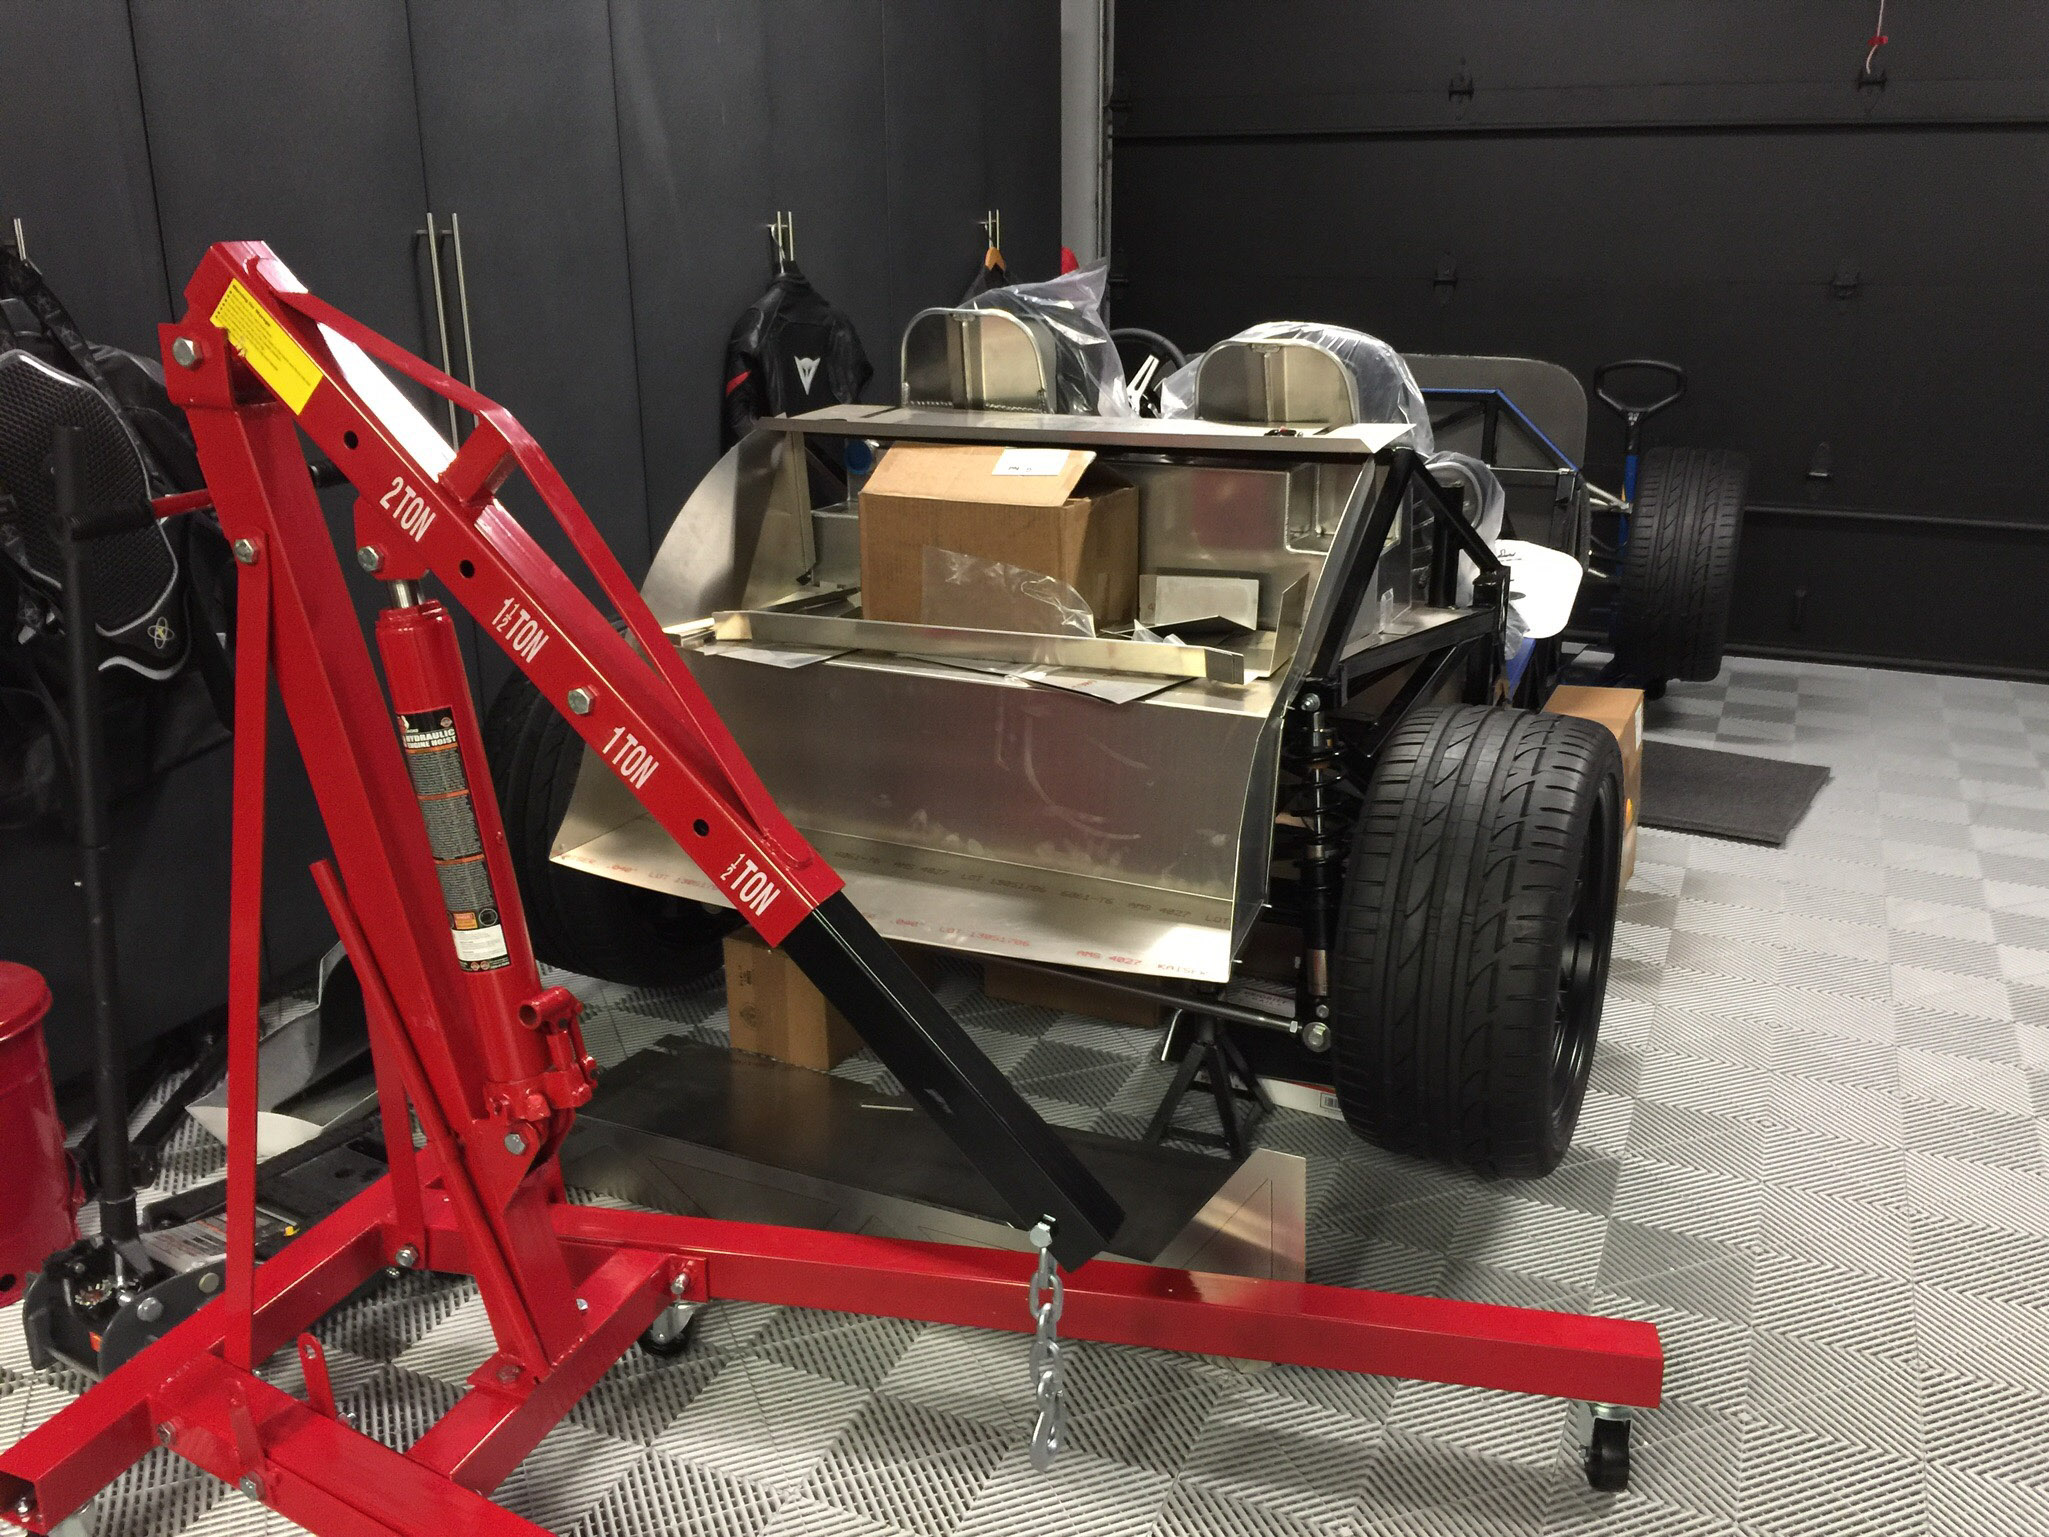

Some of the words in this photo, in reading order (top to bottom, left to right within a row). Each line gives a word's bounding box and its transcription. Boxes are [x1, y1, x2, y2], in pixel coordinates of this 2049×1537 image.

[380, 476, 404, 510] 2
[392, 485, 436, 542] TON
[505, 609, 549, 663] TON
[431, 736, 456, 746] HOIST
[602, 726, 626, 754] 1
[612, 733, 659, 789] TON
[730, 859, 781, 917] TON
[961, 873, 984, 881] LOT
[1129, 902, 1151, 912] AMS
[1159, 907, 1192, 918] 4027
[1204, 914, 1230, 924] LOT
[1076, 950, 1102, 960] AMS
[1108, 955, 1143, 966] 4027
